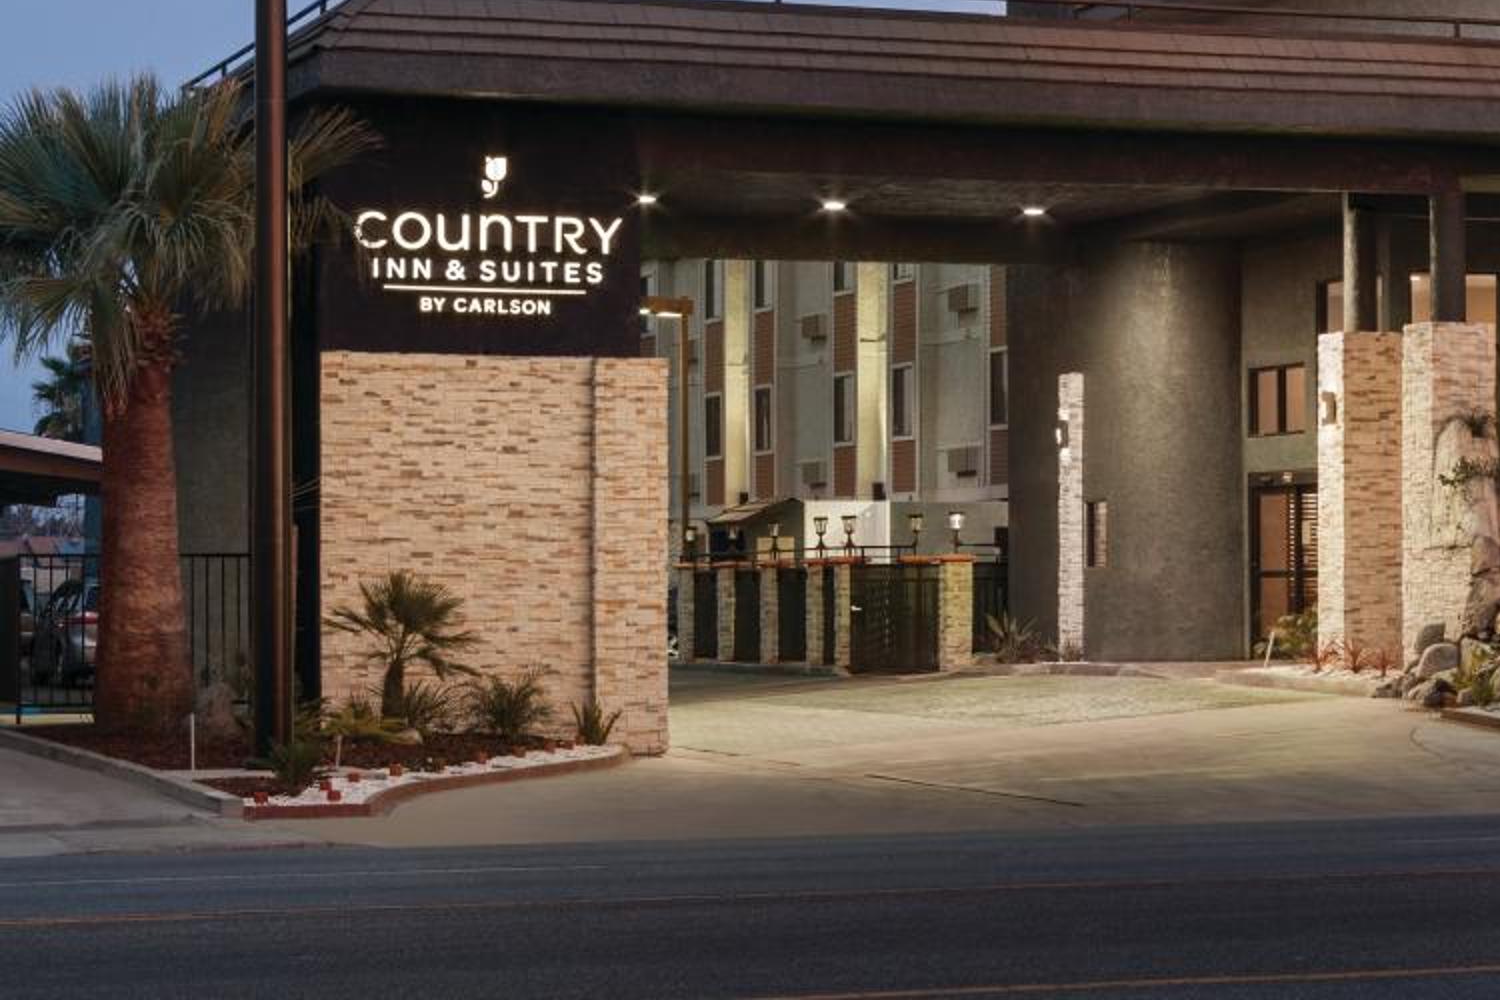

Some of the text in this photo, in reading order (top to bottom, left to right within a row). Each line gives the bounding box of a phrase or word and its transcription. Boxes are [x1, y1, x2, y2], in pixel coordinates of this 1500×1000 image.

[372, 257, 604, 285] INN & SUITES
[419, 296, 551, 316] BY CARLSON
